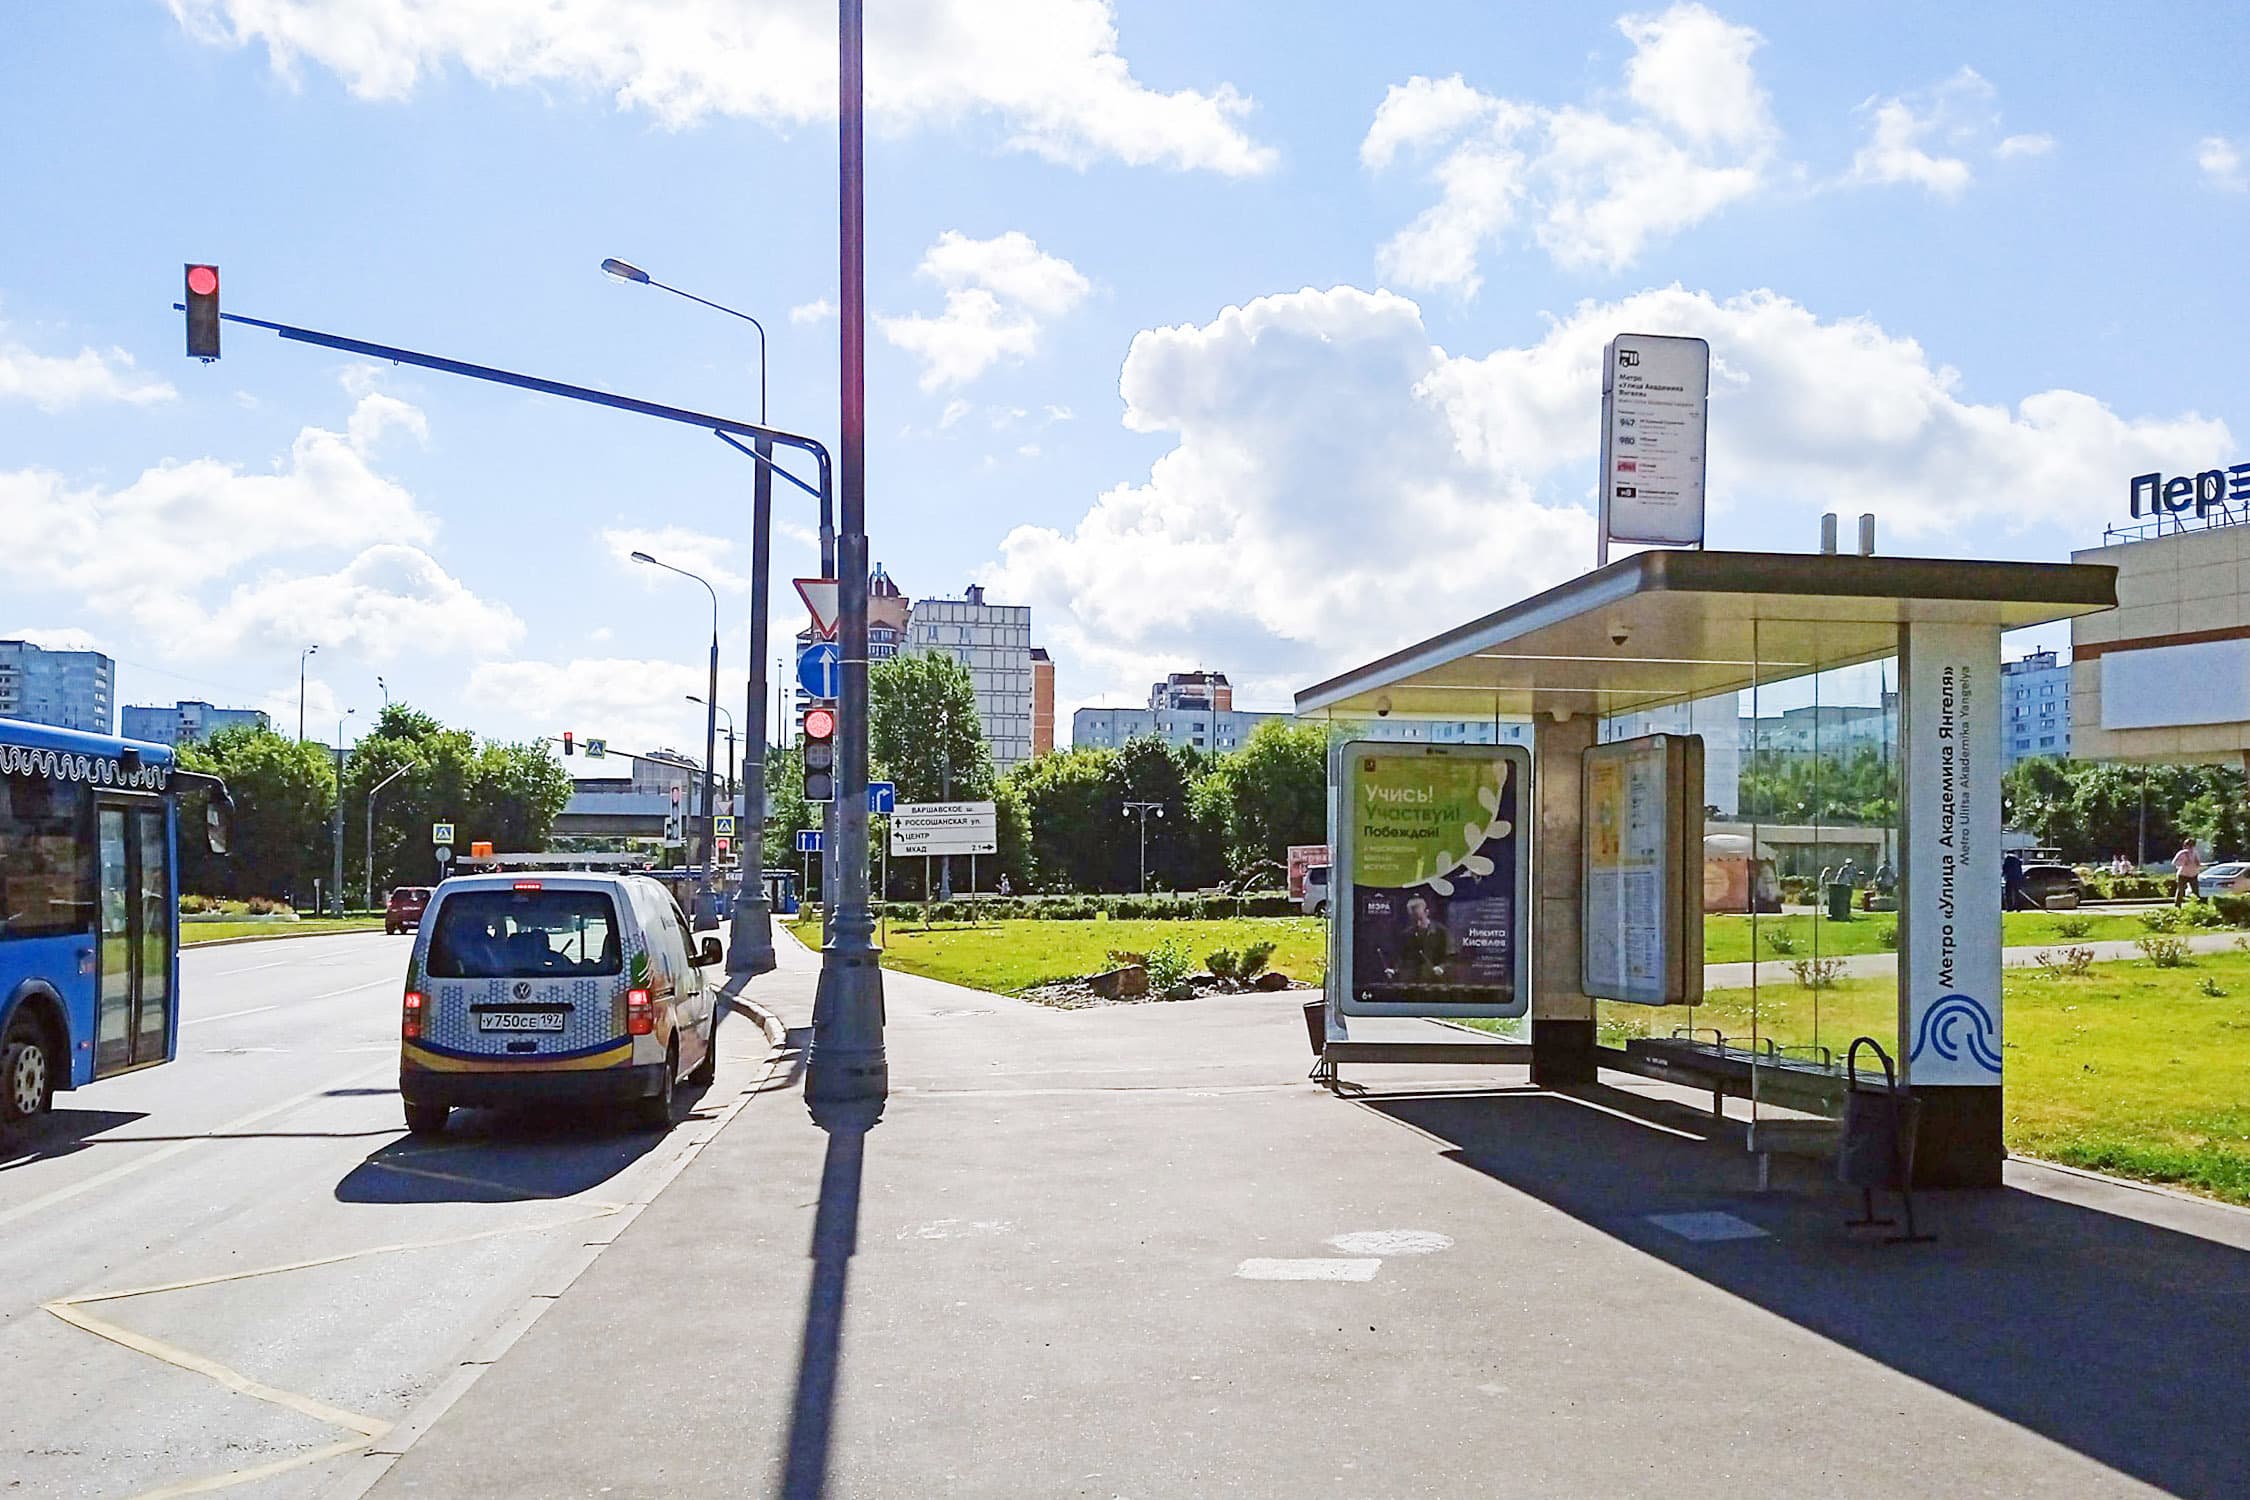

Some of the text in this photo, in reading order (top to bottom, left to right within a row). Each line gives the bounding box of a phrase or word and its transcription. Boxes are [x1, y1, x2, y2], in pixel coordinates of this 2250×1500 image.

[1620, 418, 1635, 427] 947
[1619, 436, 1635, 445] 980
[1959, 666, 1971, 866] Metro Ulitsa Akademika Yangelya
[1365, 783, 1433, 803] Учись!
[912, 806, 963, 814] ВАРШАВСКОЕ
[1365, 804, 1460, 824] Участвуй!
[905, 817, 968, 826] РОССОШАНСКАЯ
[1364, 825, 1440, 839] Побеждай!
[1938, 666, 1957, 989] Метро «Улица Академика Янгеля»
[905, 832, 930, 840] ЦЕНТР
[1469, 928, 1506, 937] Никита
[1361, 991, 1373, 1000] 6+
[541, 1014, 559, 1024] 197
